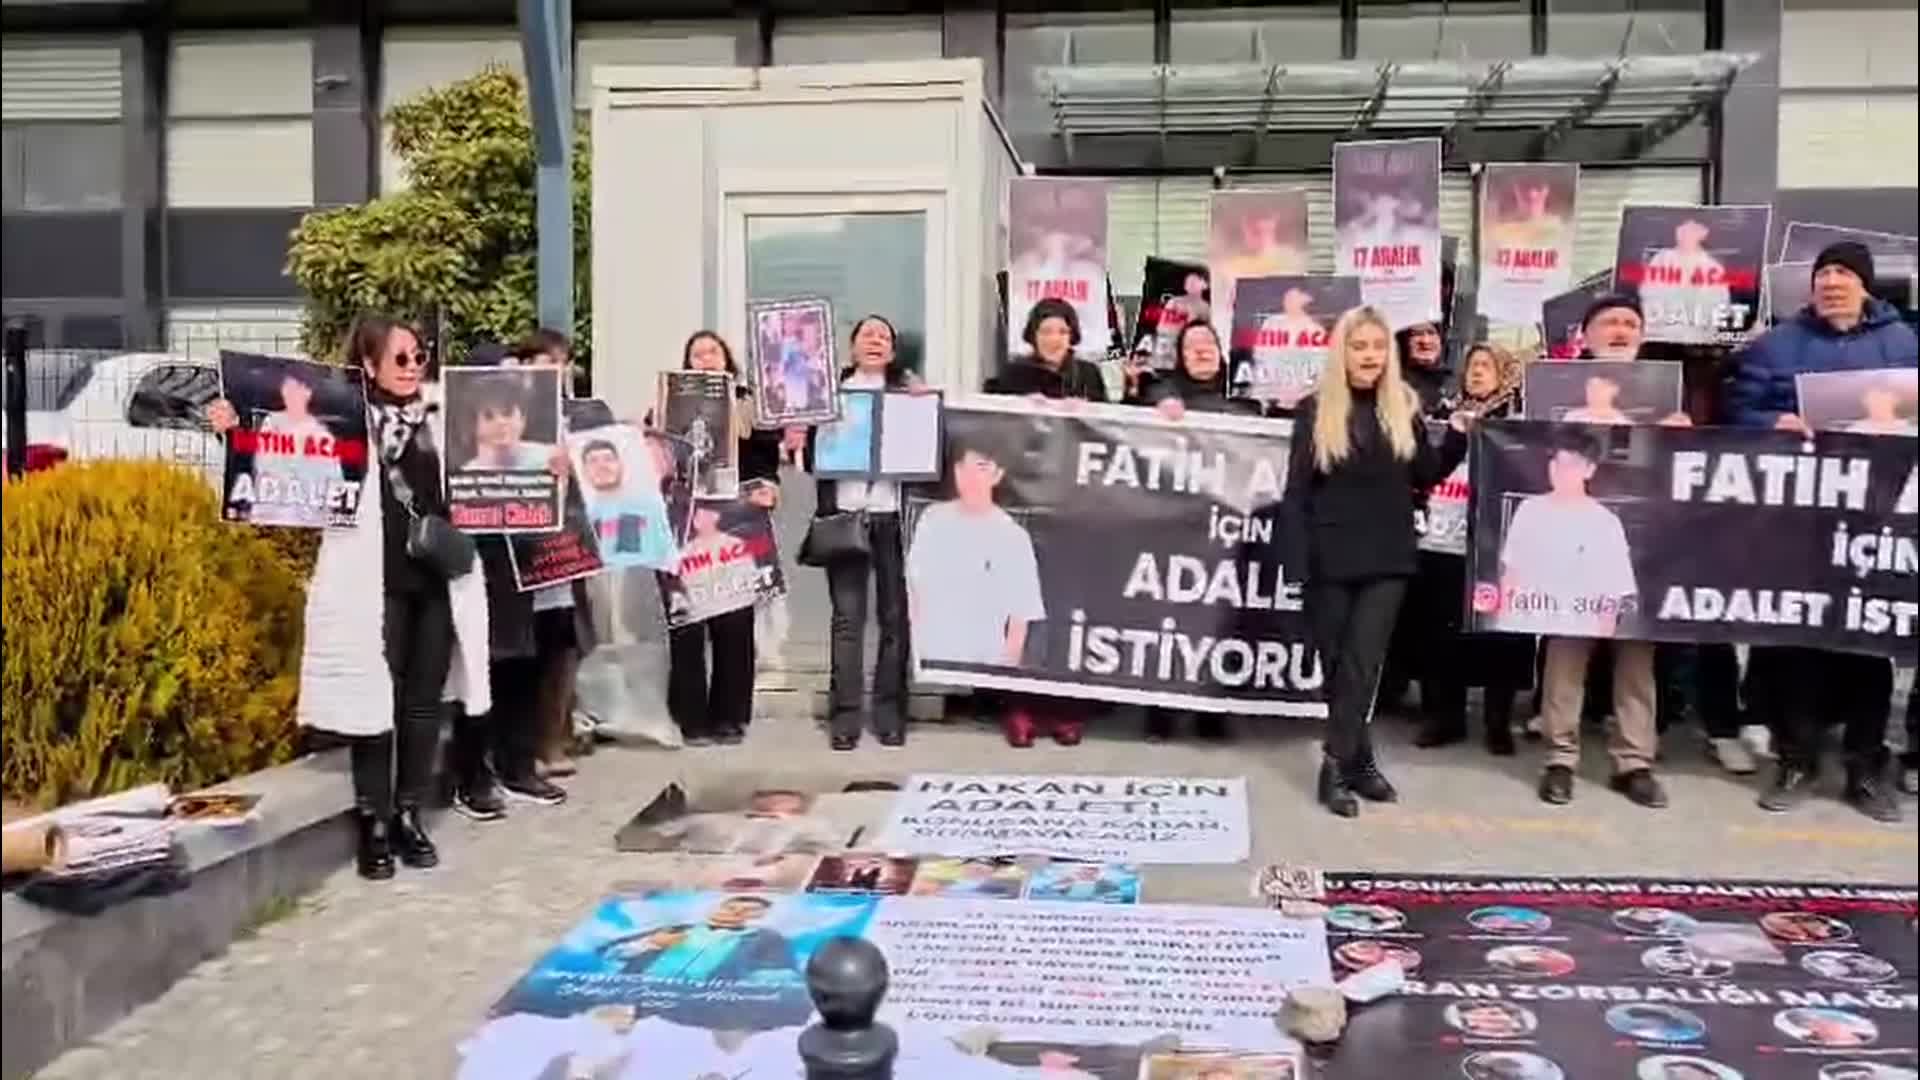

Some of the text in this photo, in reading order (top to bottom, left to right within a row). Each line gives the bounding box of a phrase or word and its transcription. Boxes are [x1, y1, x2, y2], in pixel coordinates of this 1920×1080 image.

[1075, 439, 1226, 494] FATİH
[1671, 441, 1870, 511] FATİH
[1208, 505, 1273, 548] İÇİN
[1123, 552, 1304, 612] ADALE
[1658, 585, 1919, 637] ADALET İST
[1067, 608, 1326, 690] İSTİYORU
[919, 780, 1105, 797] HAKAN
[1401, 980, 1501, 998] RAN
[1509, 980, 1769, 1006] ZORBALIĞI
